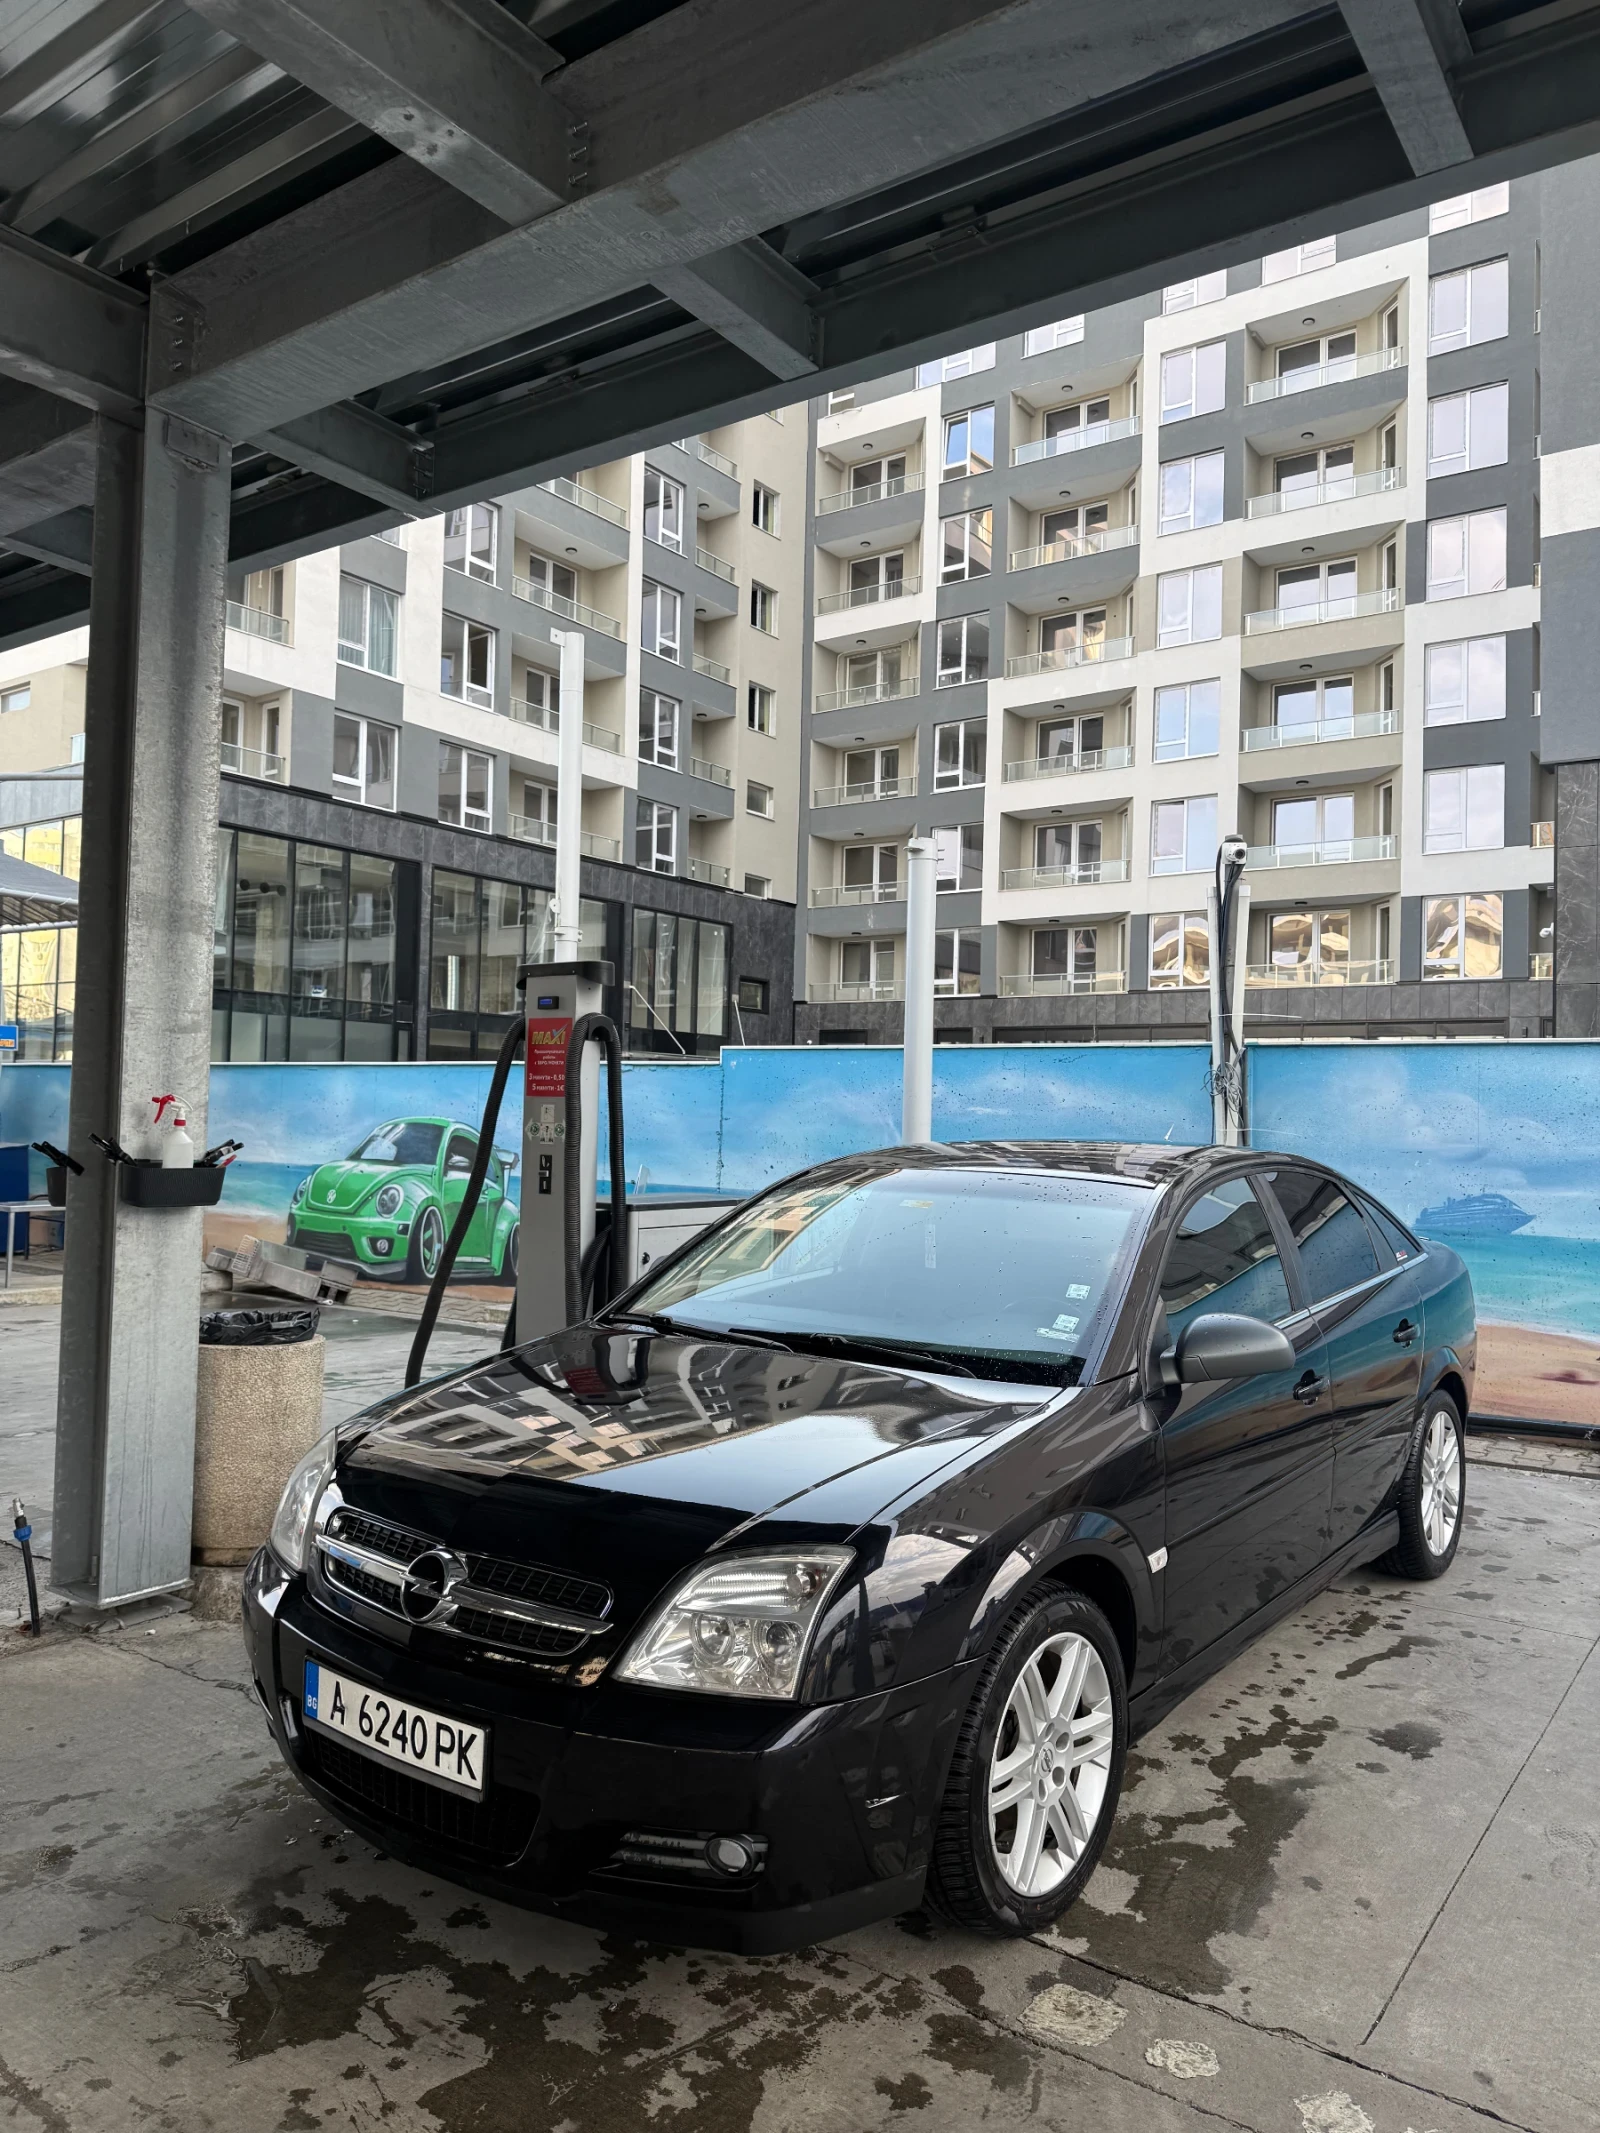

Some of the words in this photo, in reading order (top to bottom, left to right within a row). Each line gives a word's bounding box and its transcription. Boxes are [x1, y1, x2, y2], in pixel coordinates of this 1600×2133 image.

[532, 1031, 566, 1045] MAXI
[307, 1694, 318, 1710] BG
[330, 1680, 346, 1726] A
[358, 1694, 428, 1760] 6240
[434, 1721, 478, 1781] PK
